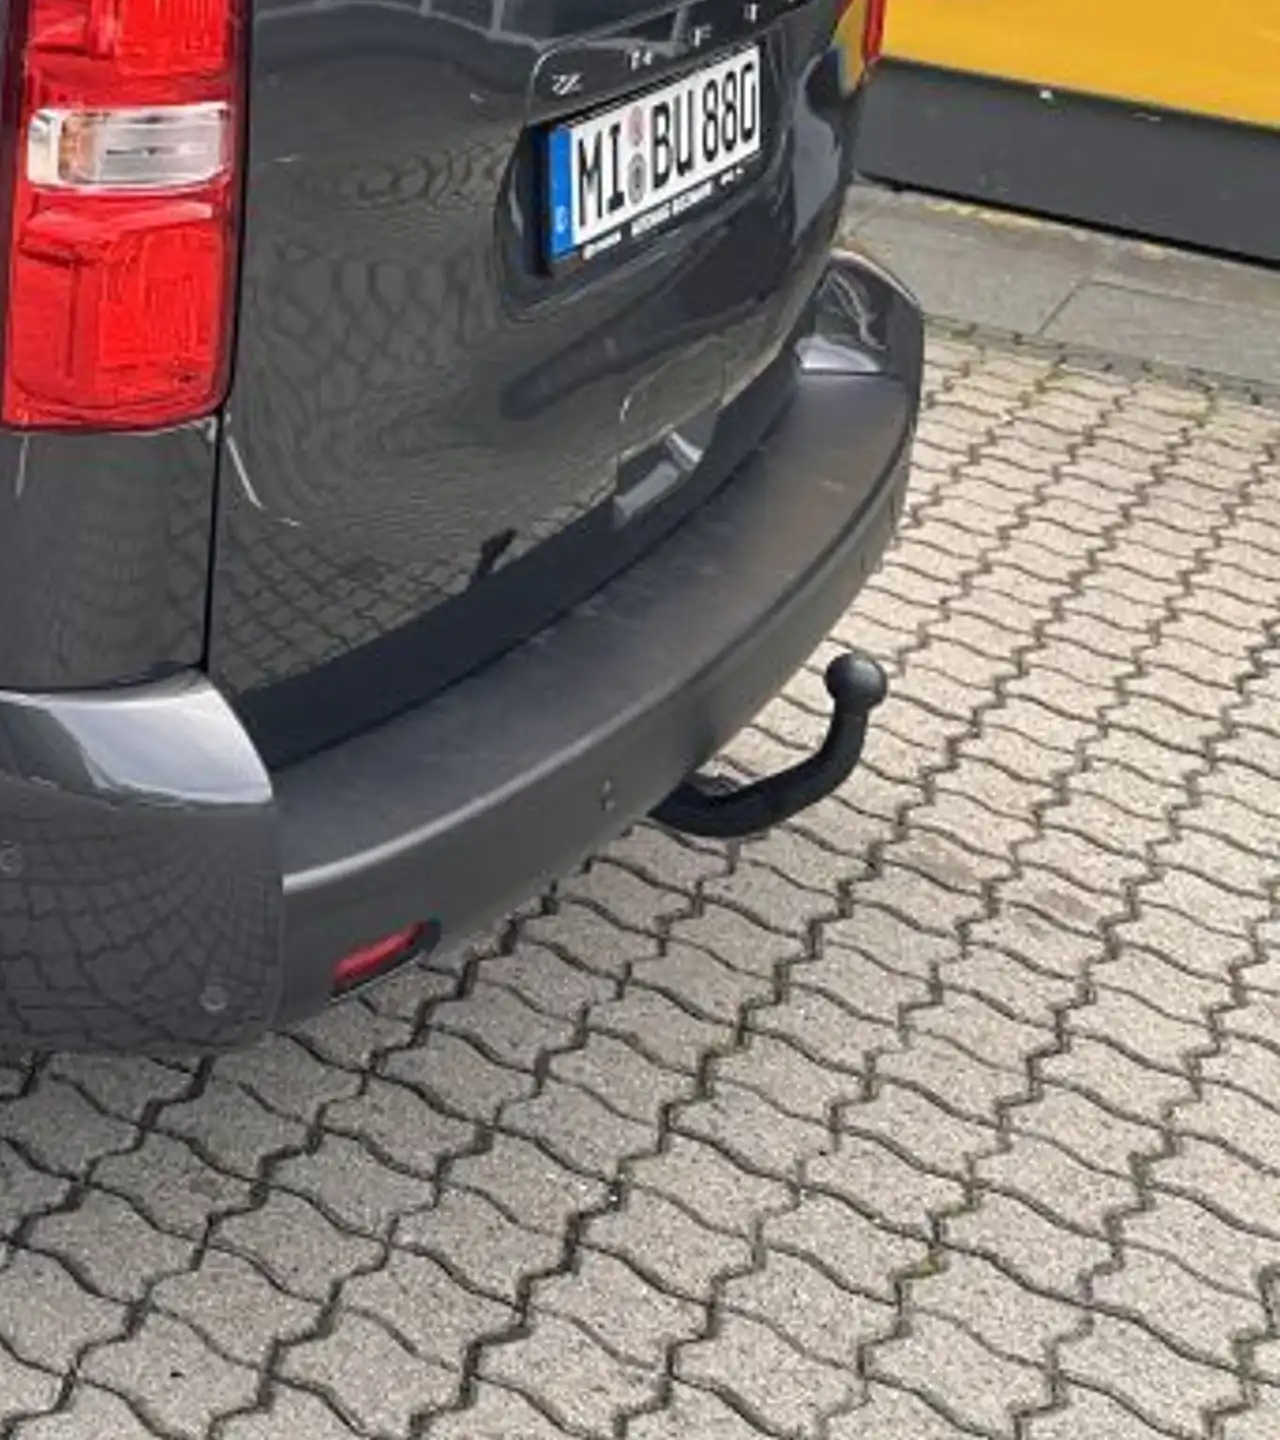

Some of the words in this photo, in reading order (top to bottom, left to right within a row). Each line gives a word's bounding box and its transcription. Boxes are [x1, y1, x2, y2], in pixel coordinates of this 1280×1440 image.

[578, 121, 625, 227] MI
[650, 89, 695, 190] BU
[701, 61, 756, 163] 880
